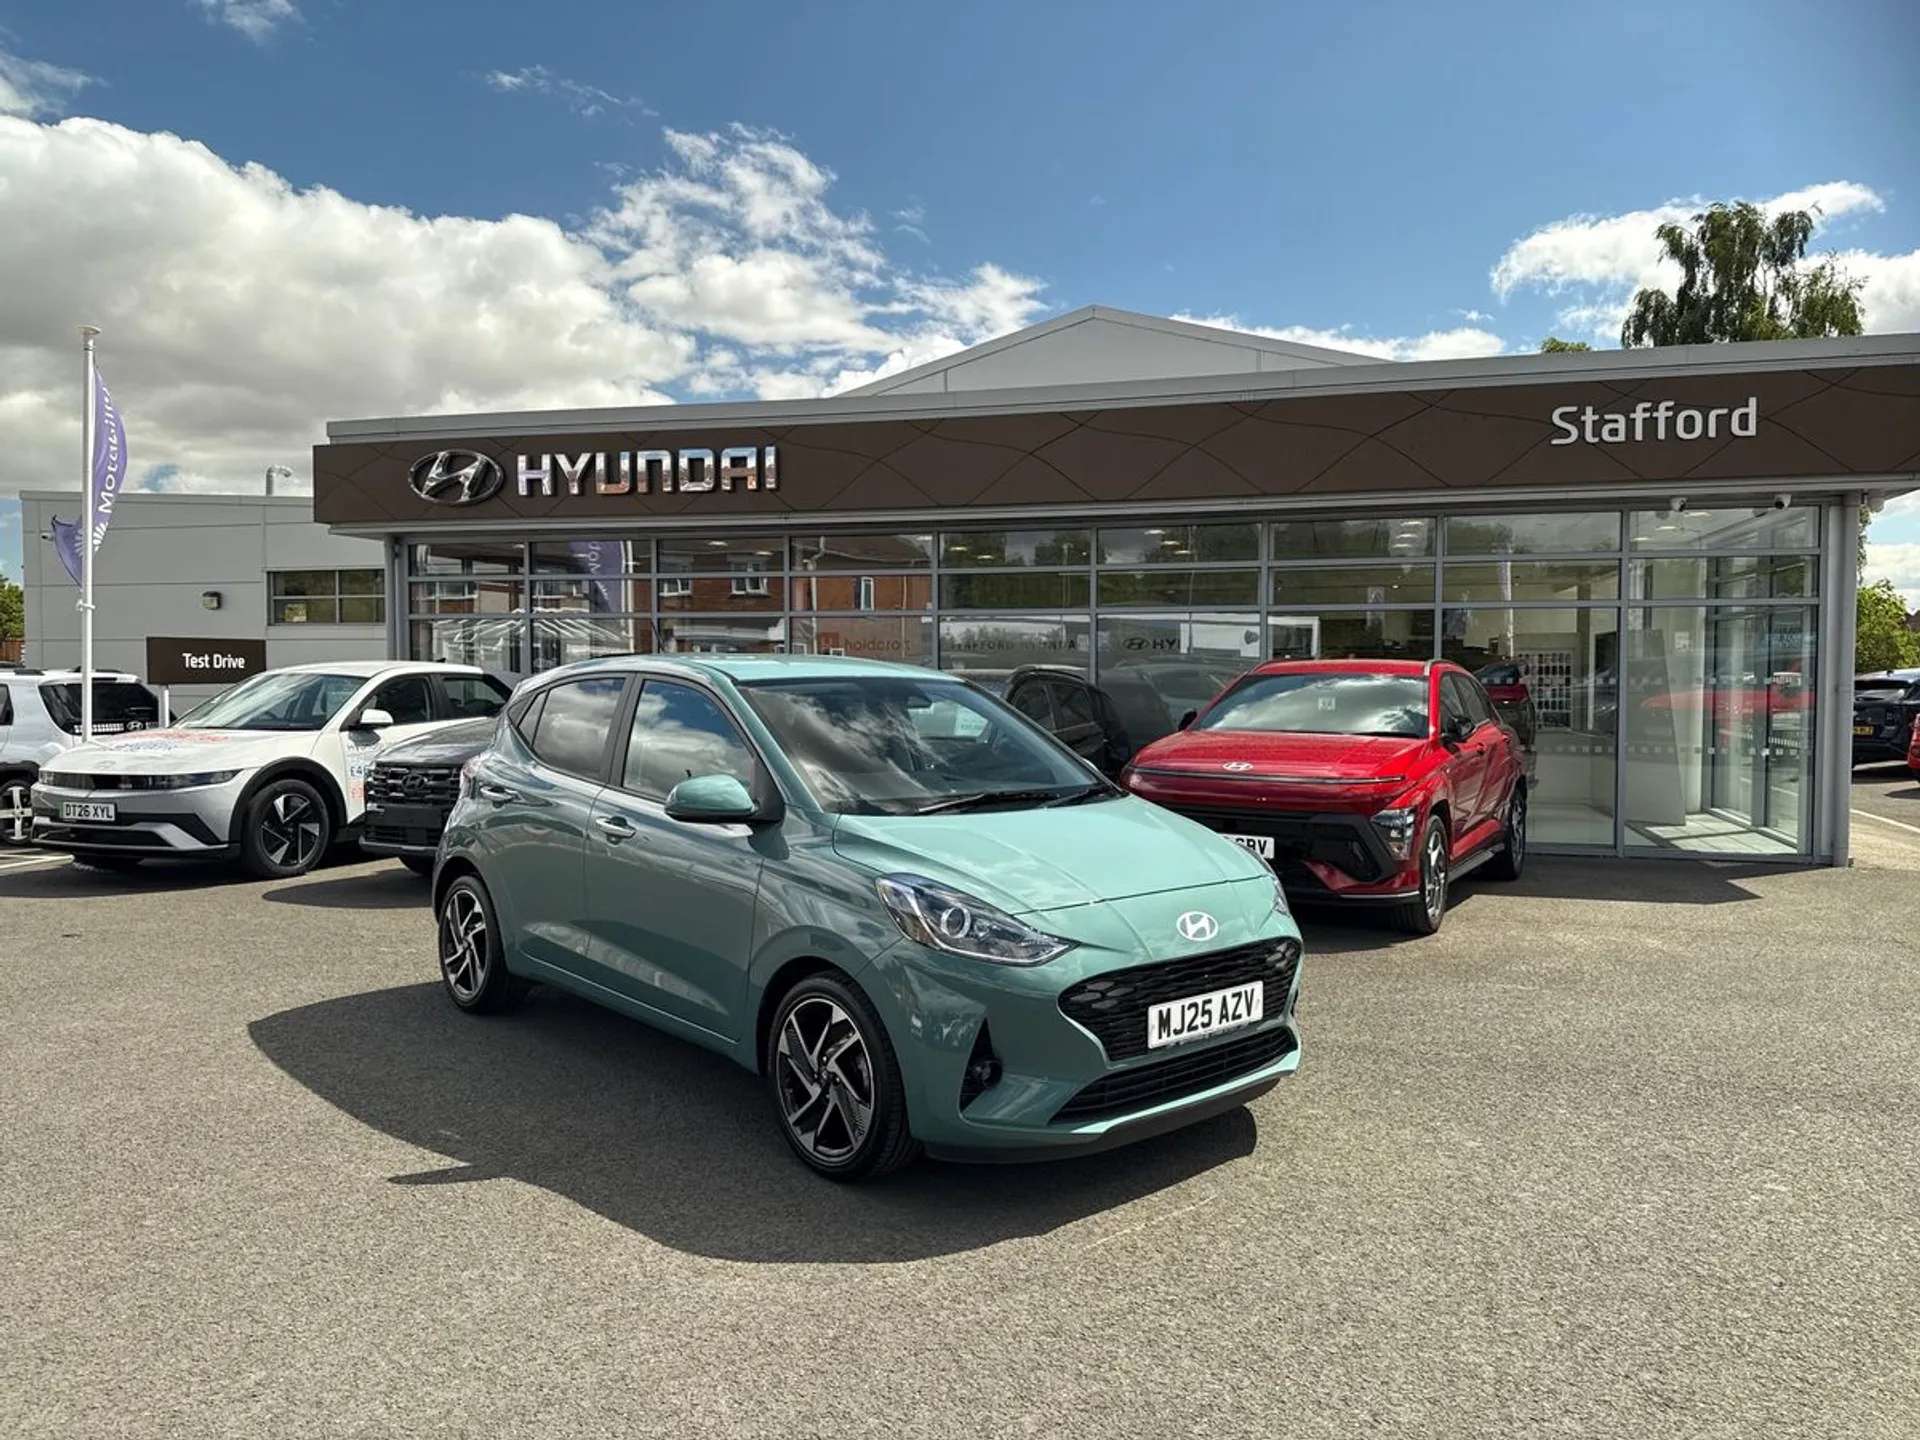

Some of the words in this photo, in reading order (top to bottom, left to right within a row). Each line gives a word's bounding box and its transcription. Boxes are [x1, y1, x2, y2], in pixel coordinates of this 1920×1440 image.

[1550, 397, 1757, 446] Stafford
[517, 446, 776, 496] HYUNDAI
[182, 653, 210, 669] Test
[213, 653, 245, 669] Drive
[65, 804, 90, 818] DT26
[92, 805, 113, 819] XYL
[1158, 998, 1212, 1040] MJ25
[1219, 988, 1254, 1025] AZV
